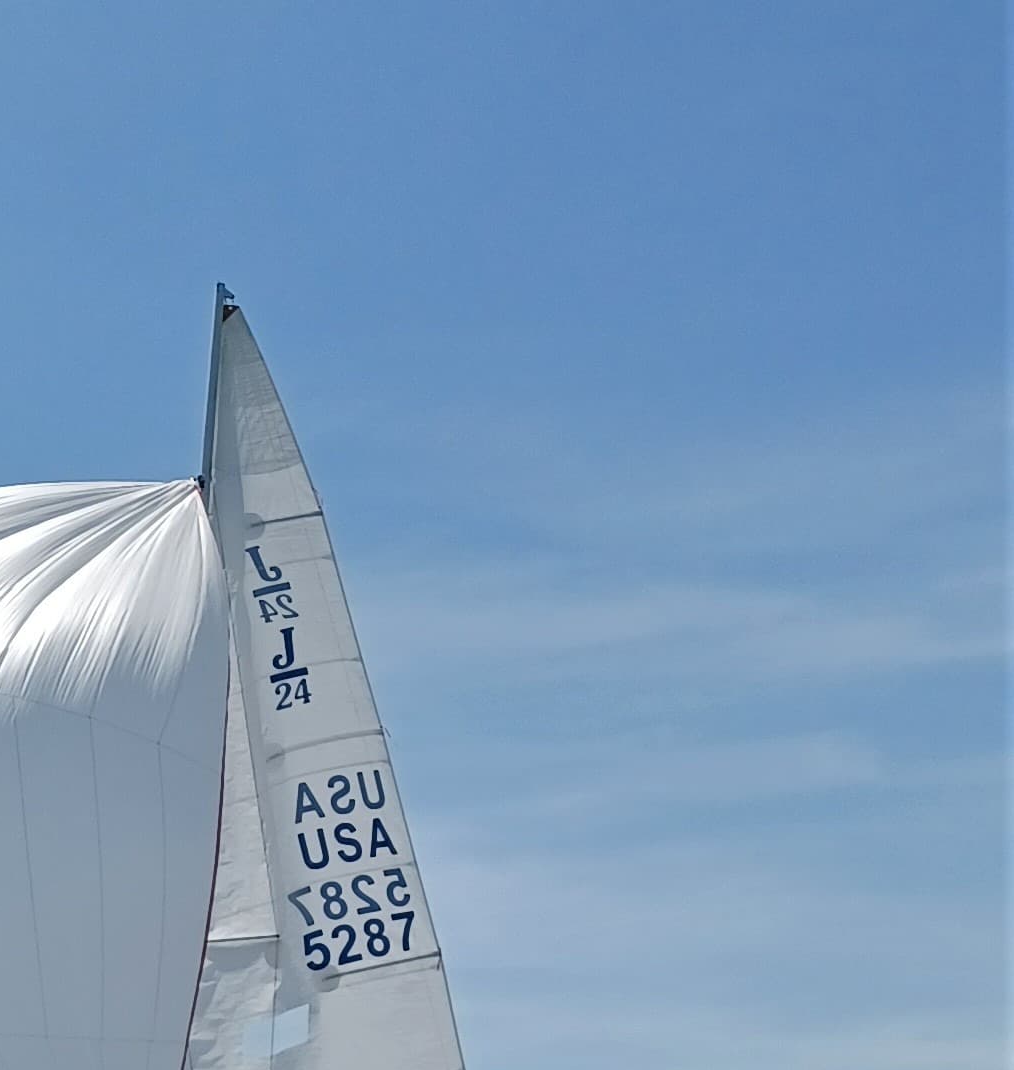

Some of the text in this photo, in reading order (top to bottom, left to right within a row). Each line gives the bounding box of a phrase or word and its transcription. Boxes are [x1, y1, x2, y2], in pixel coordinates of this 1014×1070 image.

[272, 626, 295, 670] J
[274, 678, 312, 711] 24
[297, 817, 398, 870] USA
[303, 910, 415, 971] 5287
